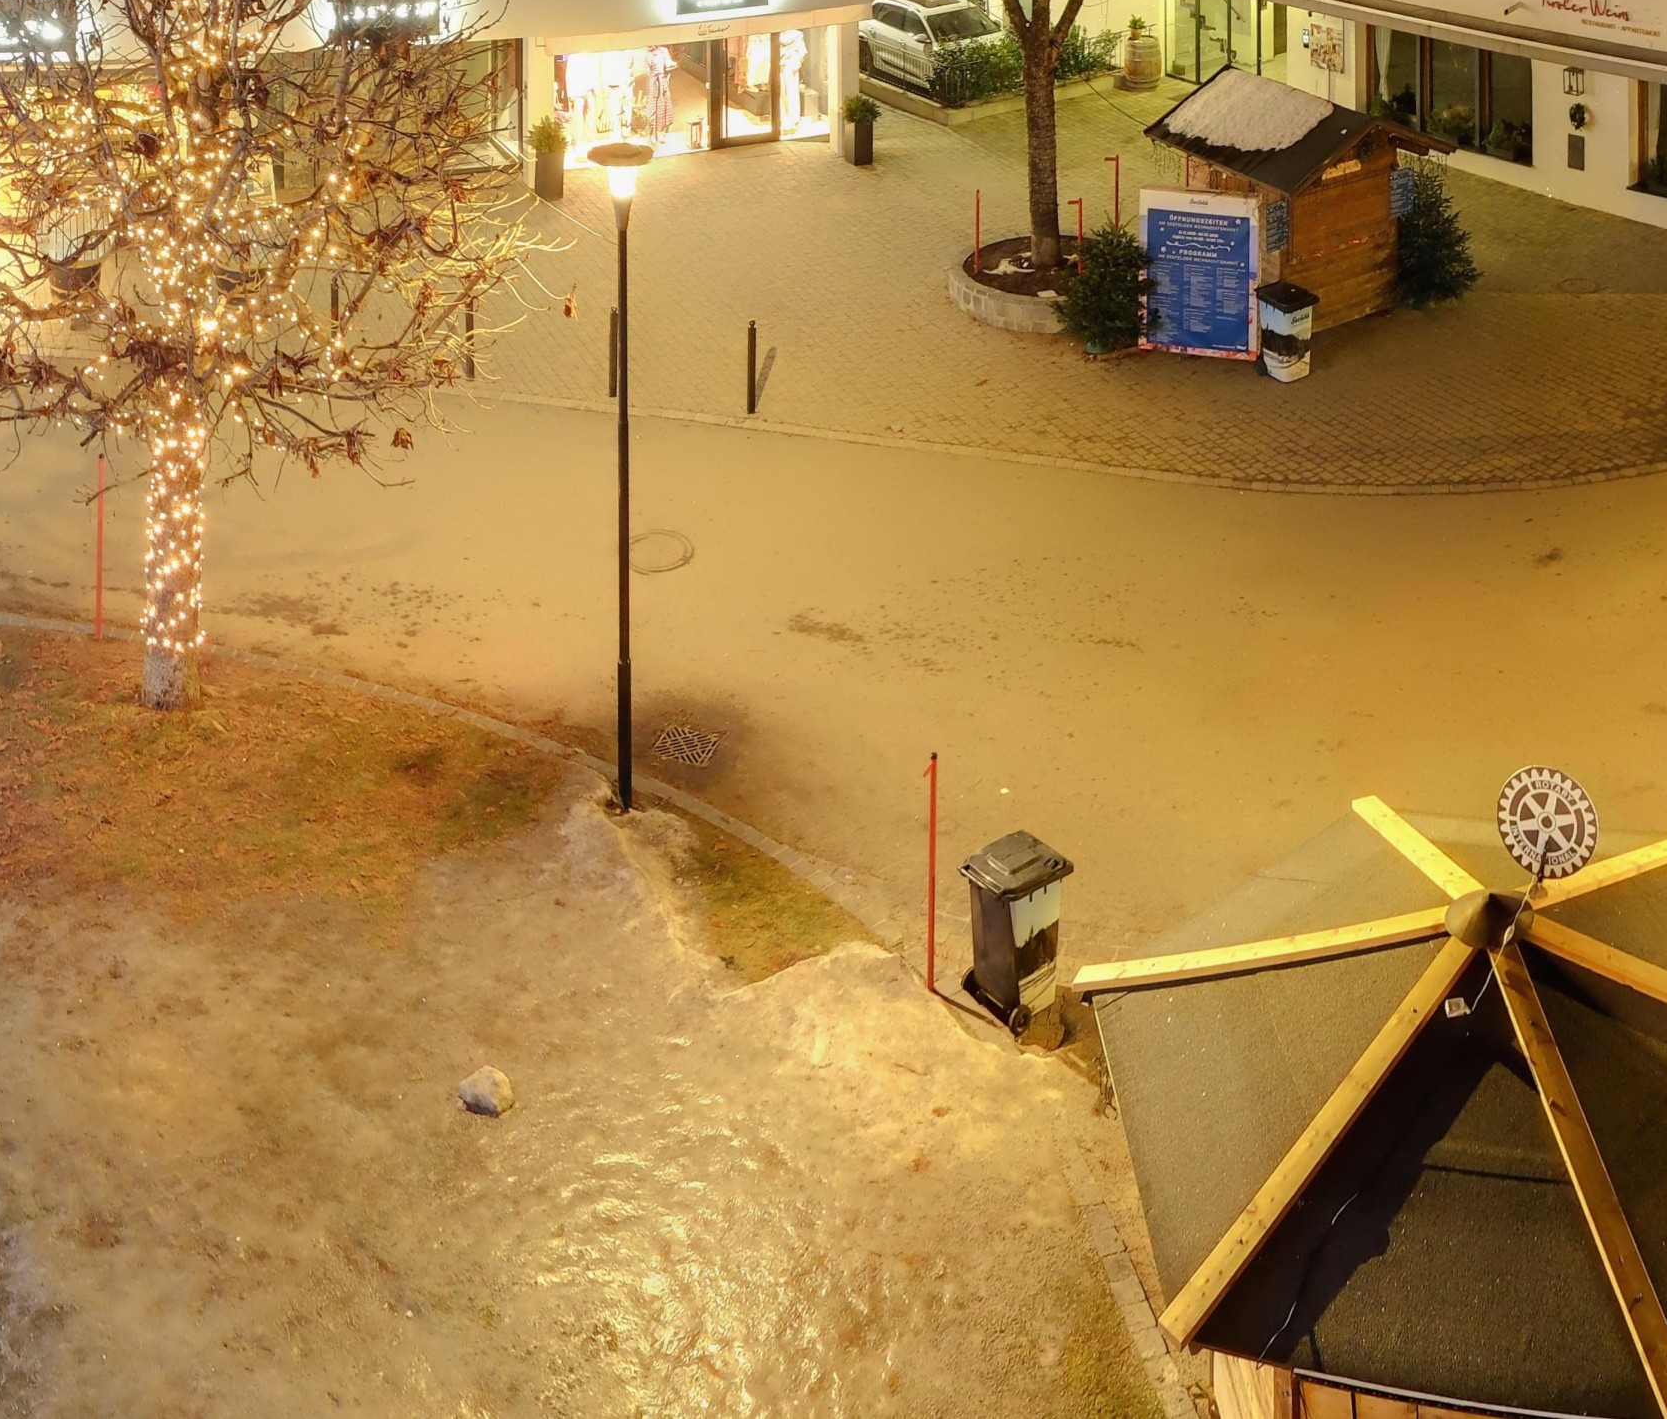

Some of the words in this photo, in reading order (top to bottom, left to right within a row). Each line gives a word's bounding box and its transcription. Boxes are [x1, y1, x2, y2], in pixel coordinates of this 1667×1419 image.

[1178, 248, 1218, 259] PROGRAMM
[1535, 780, 1576, 802] ROTARY
[1511, 824, 1577, 866] INTERNAIONAL
